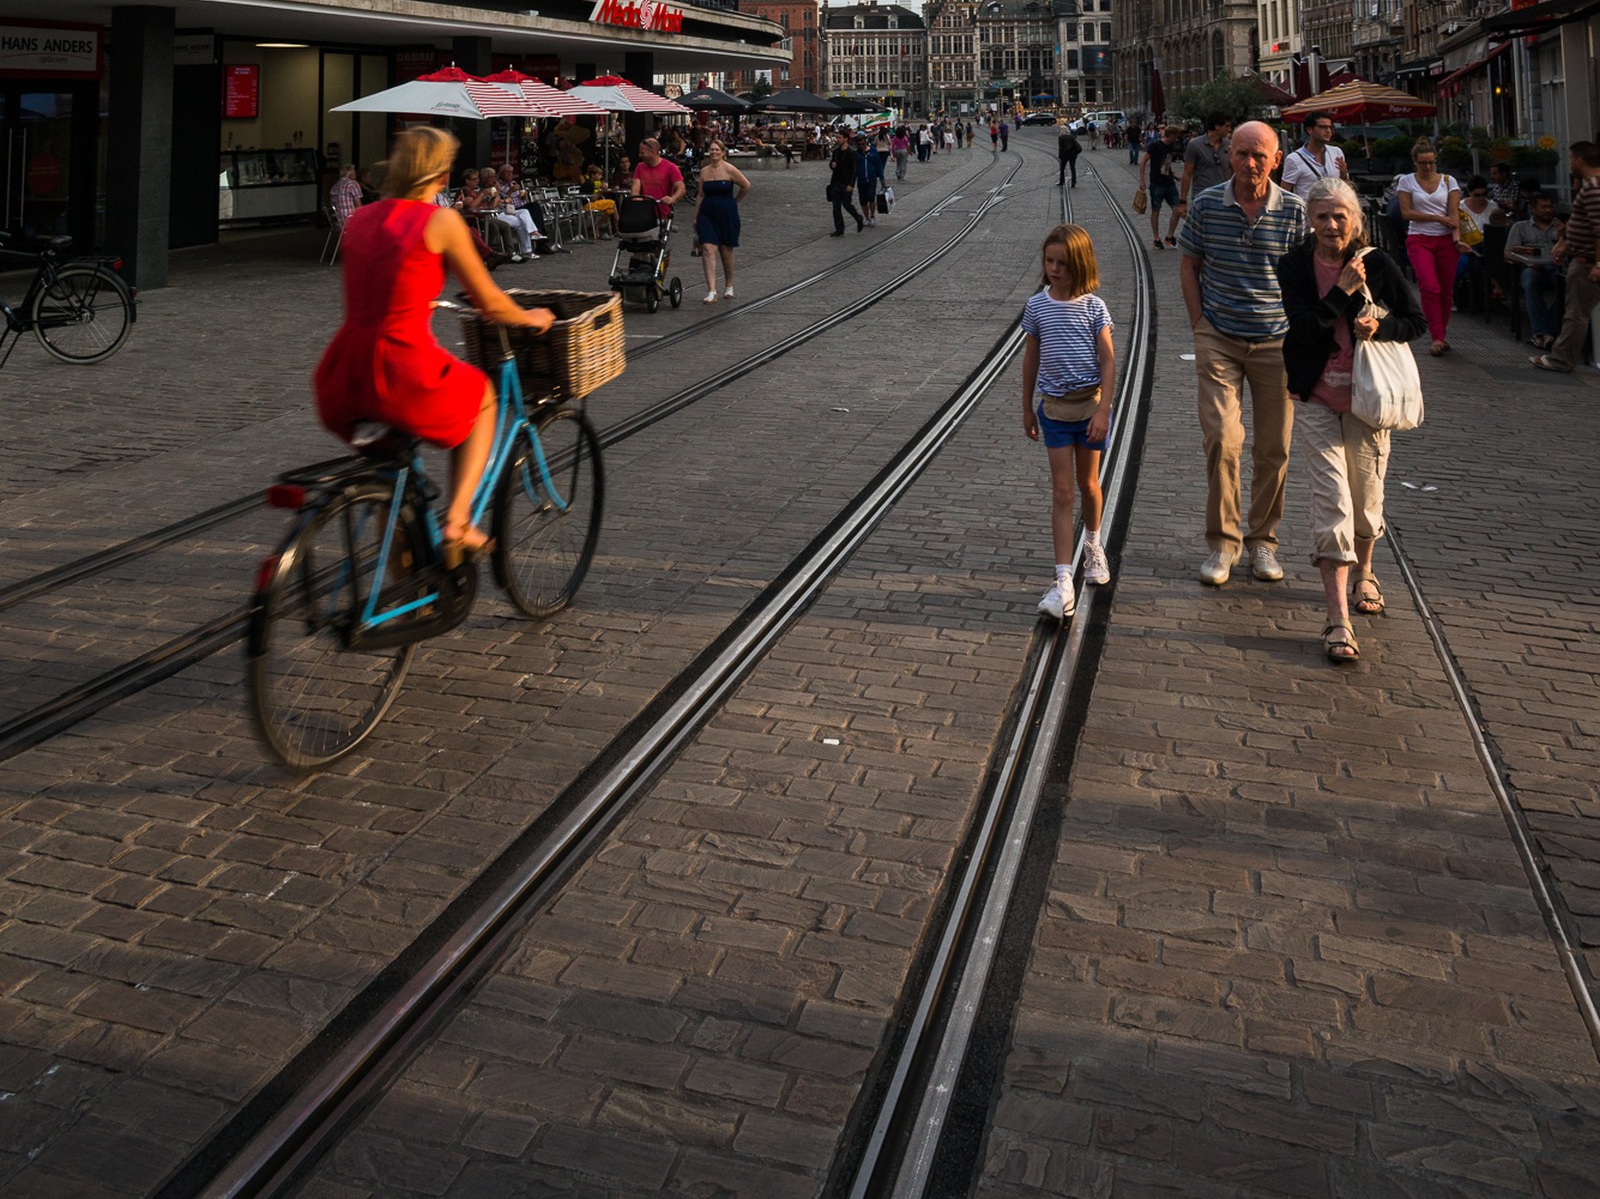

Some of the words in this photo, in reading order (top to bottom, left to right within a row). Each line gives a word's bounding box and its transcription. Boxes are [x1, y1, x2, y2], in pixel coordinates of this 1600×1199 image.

[648, 2, 684, 34] Markt
[1, 36, 39, 52] HANS
[43, 38, 93, 54] ANDERS
